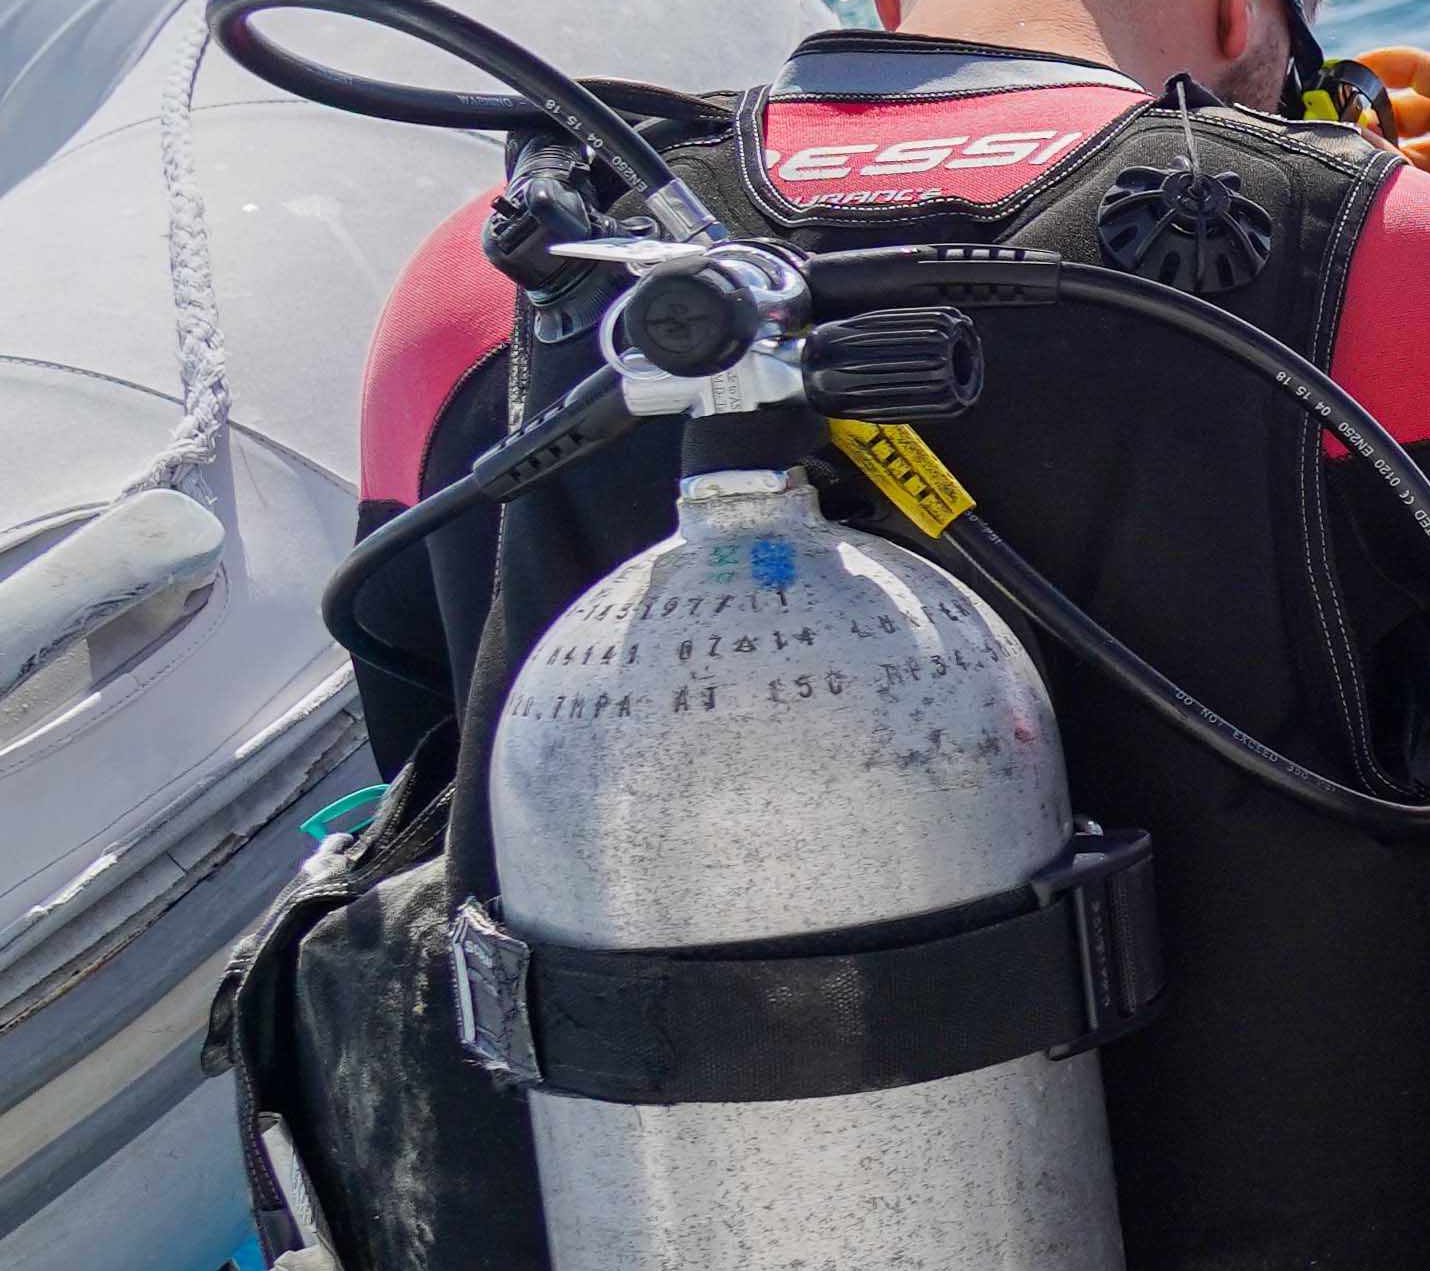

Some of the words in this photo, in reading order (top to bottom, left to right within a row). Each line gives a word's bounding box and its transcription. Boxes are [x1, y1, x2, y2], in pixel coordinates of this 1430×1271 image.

[545, 99, 562, 114] 18
[566, 114, 584, 130] 15
[586, 132, 604, 149] 04
[610, 155, 649, 194] EN250
[1275, 370, 1291, 386] 18
[1295, 384, 1312, 401] 15
[1315, 399, 1333, 418] 04
[1337, 421, 1375, 458] EN250
[1374, 458, 1401, 487] 0120
